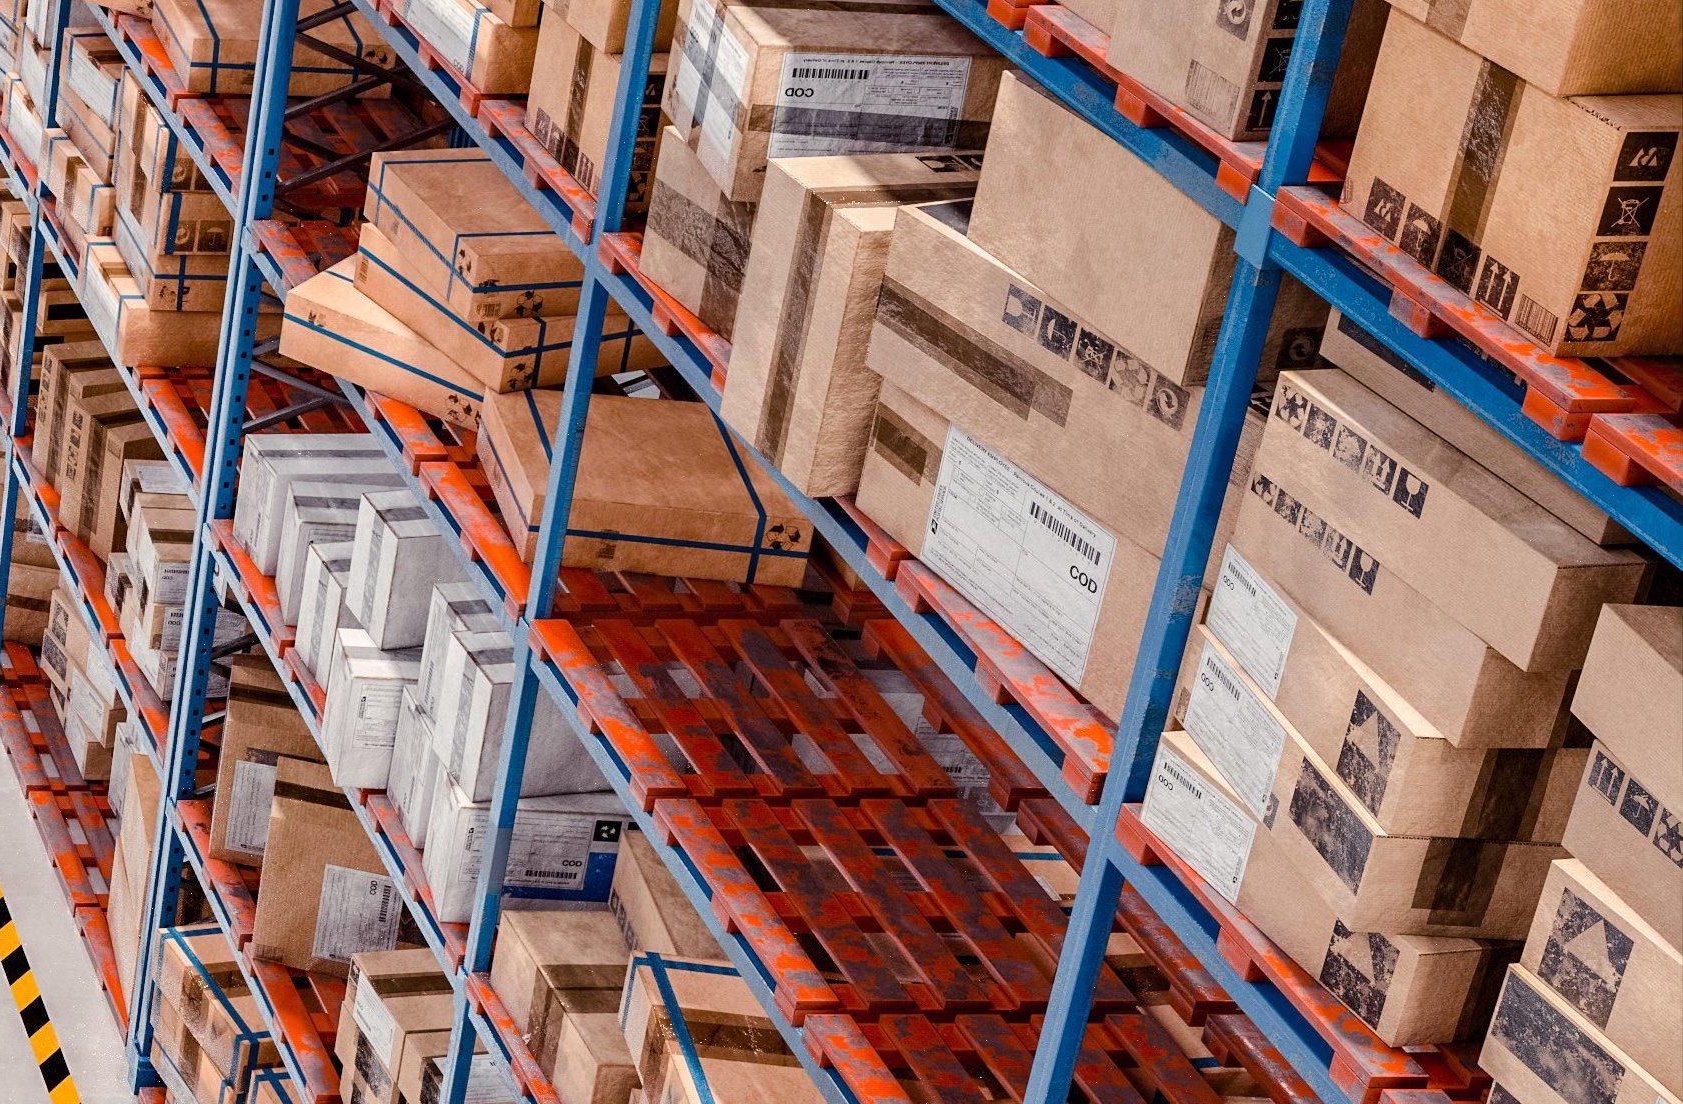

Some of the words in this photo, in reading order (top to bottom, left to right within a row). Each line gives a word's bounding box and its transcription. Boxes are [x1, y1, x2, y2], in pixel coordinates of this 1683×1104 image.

[965, 434, 987, 454] DELIVERY
[986, 450, 1010, 472] EMPLOYEE
[1068, 565, 1098, 595] COD
[562, 859, 583, 868] COD
